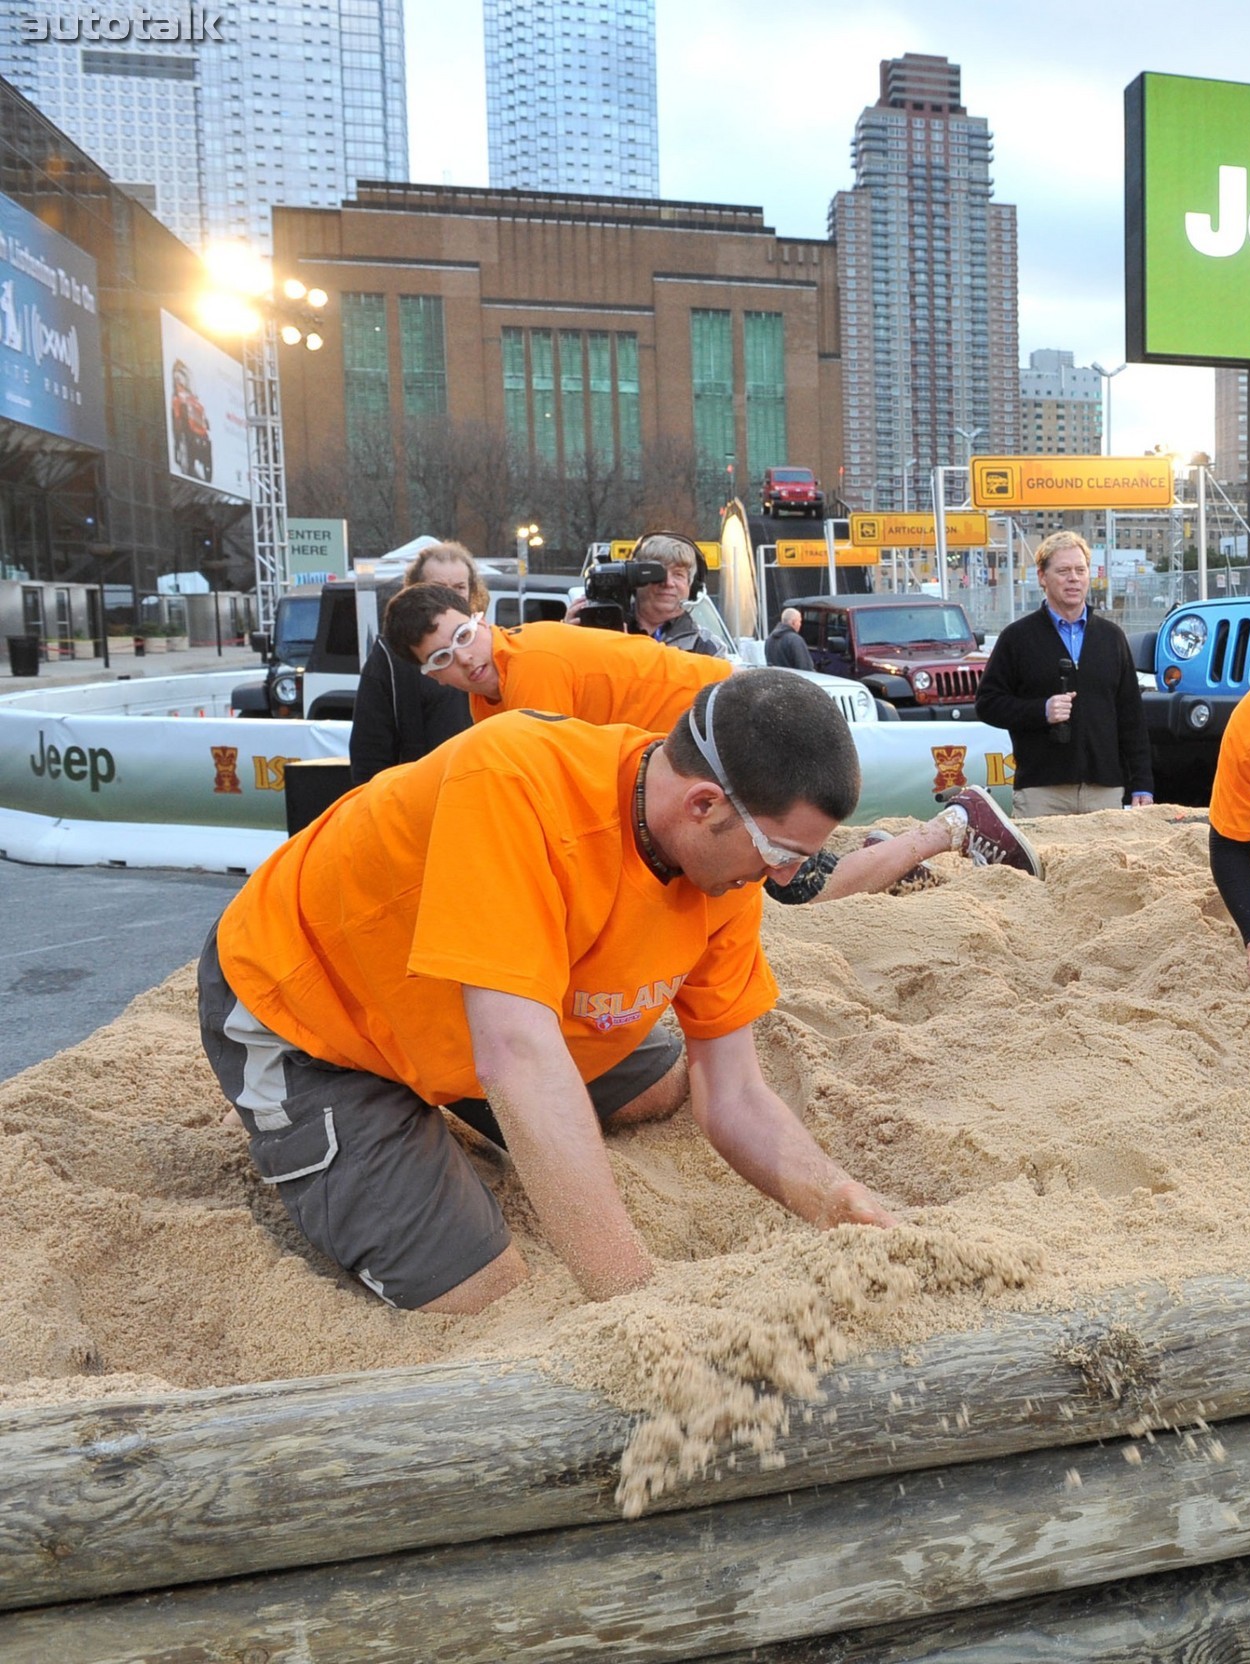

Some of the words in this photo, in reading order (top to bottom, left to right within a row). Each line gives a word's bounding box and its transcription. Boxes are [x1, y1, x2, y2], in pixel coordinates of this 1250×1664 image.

[1026, 477, 1083, 489] GROUND
[1087, 477, 1165, 488] CLEARANCE
[288, 529, 332, 540] ENTER
[888, 526, 957, 535] ARTICULAON
[291, 545, 328, 556] HERE
[30, 730, 116, 792] Jeep
